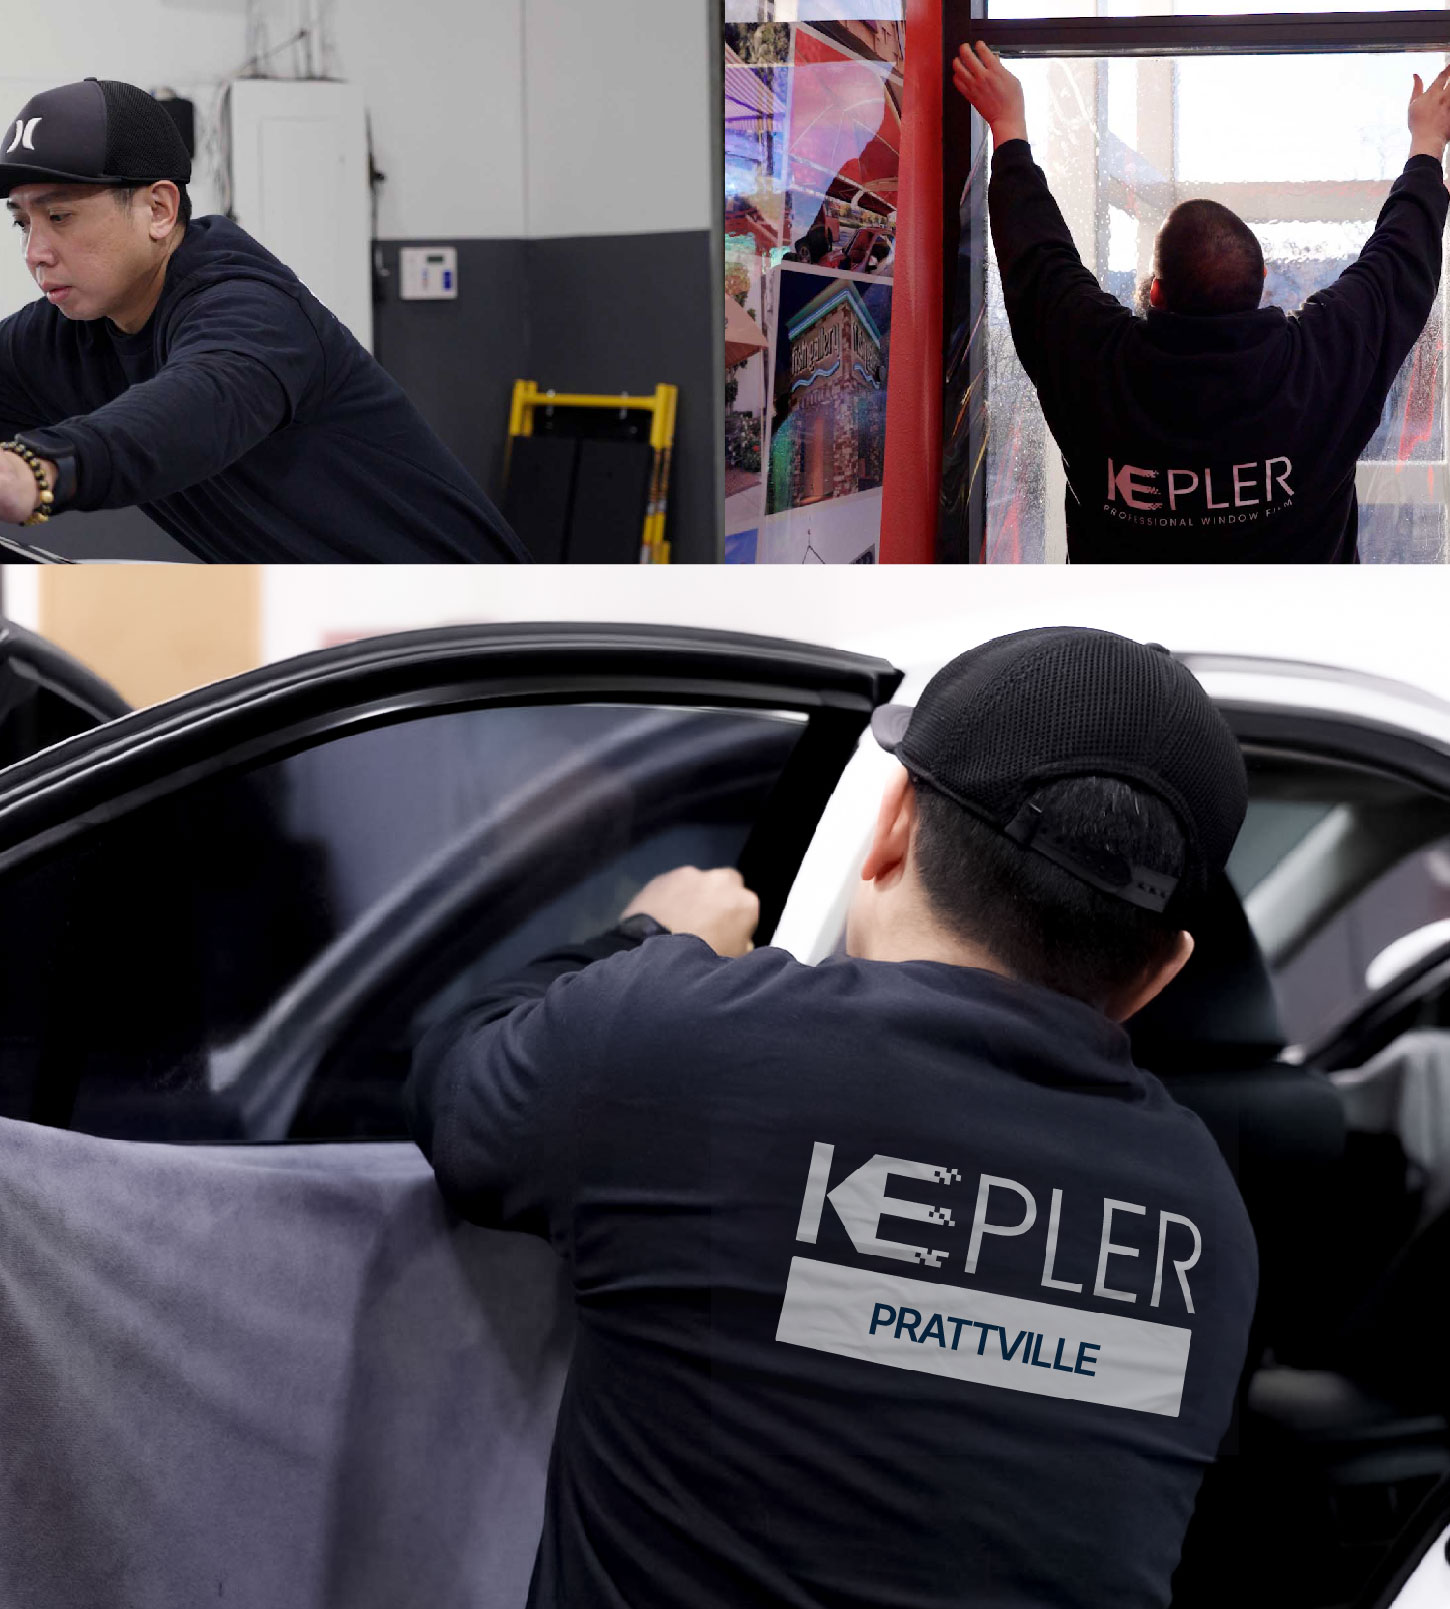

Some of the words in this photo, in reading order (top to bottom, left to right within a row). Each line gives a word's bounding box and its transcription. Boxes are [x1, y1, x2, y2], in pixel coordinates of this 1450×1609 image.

[1103, 504, 1194, 527] PROFESSIONAL
[1201, 511, 1259, 526] WINDOW
[1265, 498, 1293, 517] FIM
[1107, 456, 1295, 511] KEPLER
[796, 1141, 1202, 1314] KEPLER
[869, 1302, 1101, 1377] PRATTVILLE
